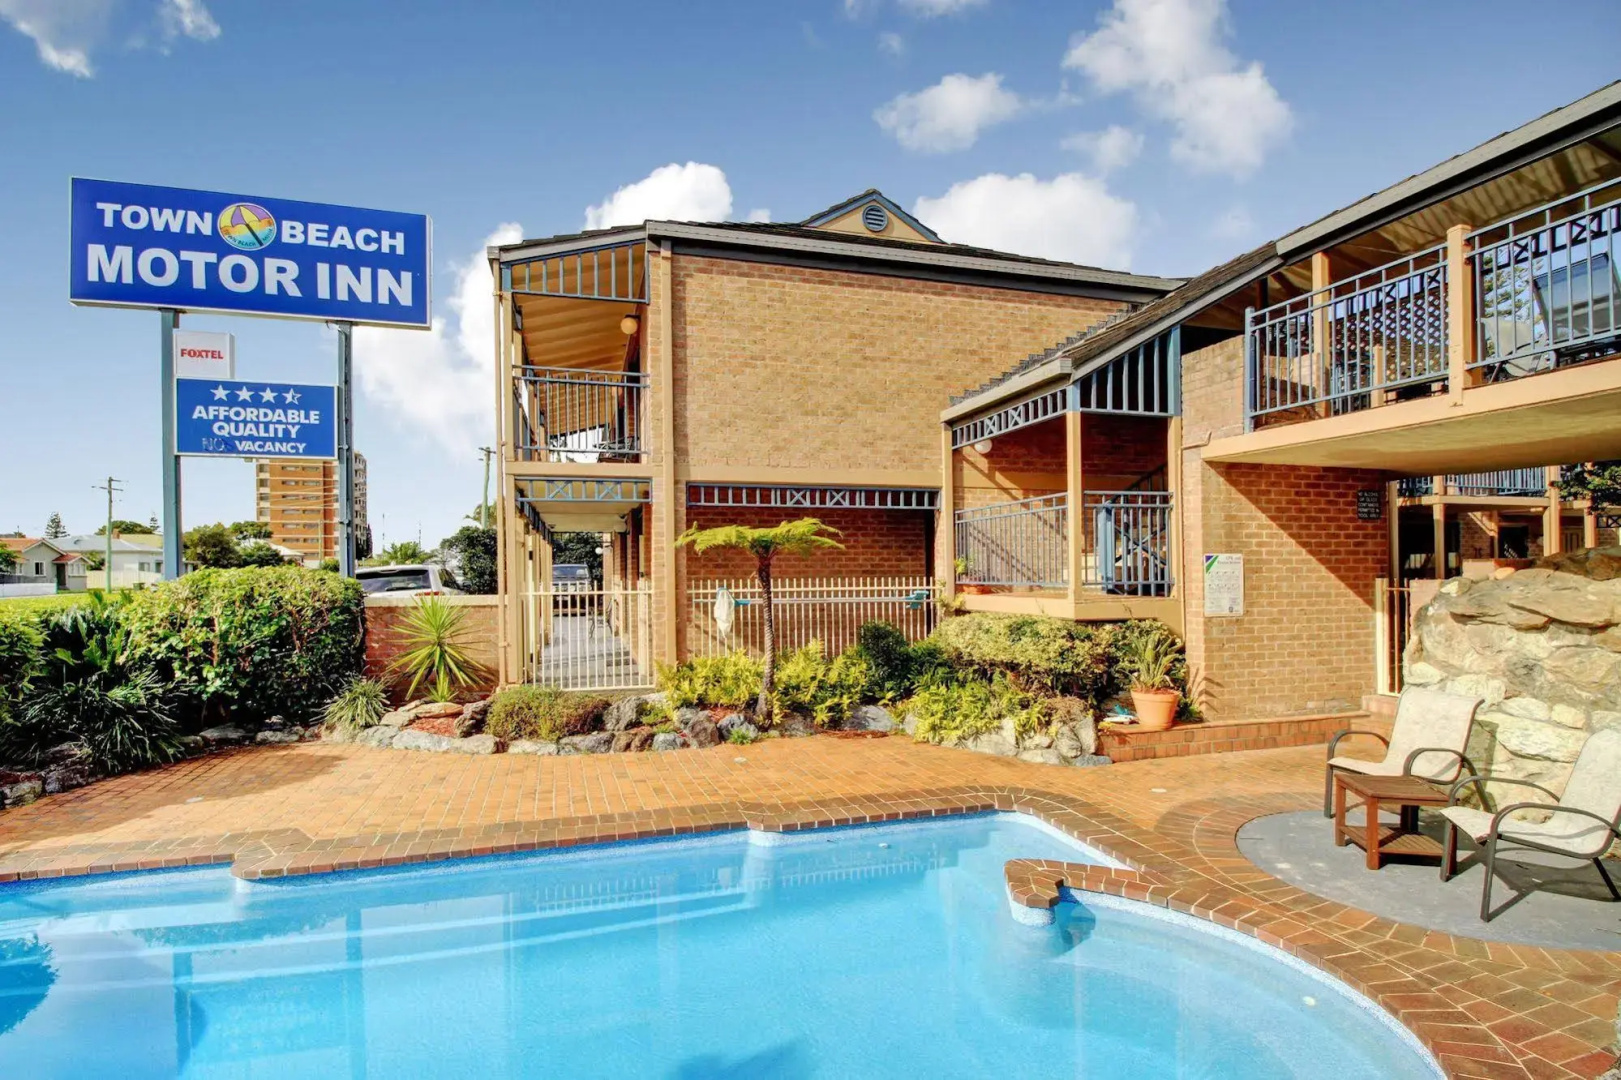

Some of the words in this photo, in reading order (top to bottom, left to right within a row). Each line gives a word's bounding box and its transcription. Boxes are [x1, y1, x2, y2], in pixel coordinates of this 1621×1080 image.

[96, 202, 212, 236] TOWN
[282, 220, 405, 255] BEACH
[87, 243, 303, 298] MOTOR
[316, 262, 413, 307] INN
[180, 348, 224, 360] FOXTEL
[192, 405, 320, 425] AFFORDABLE
[212, 422, 301, 439] QUALITY
[235, 440, 307, 454] VACANCY
